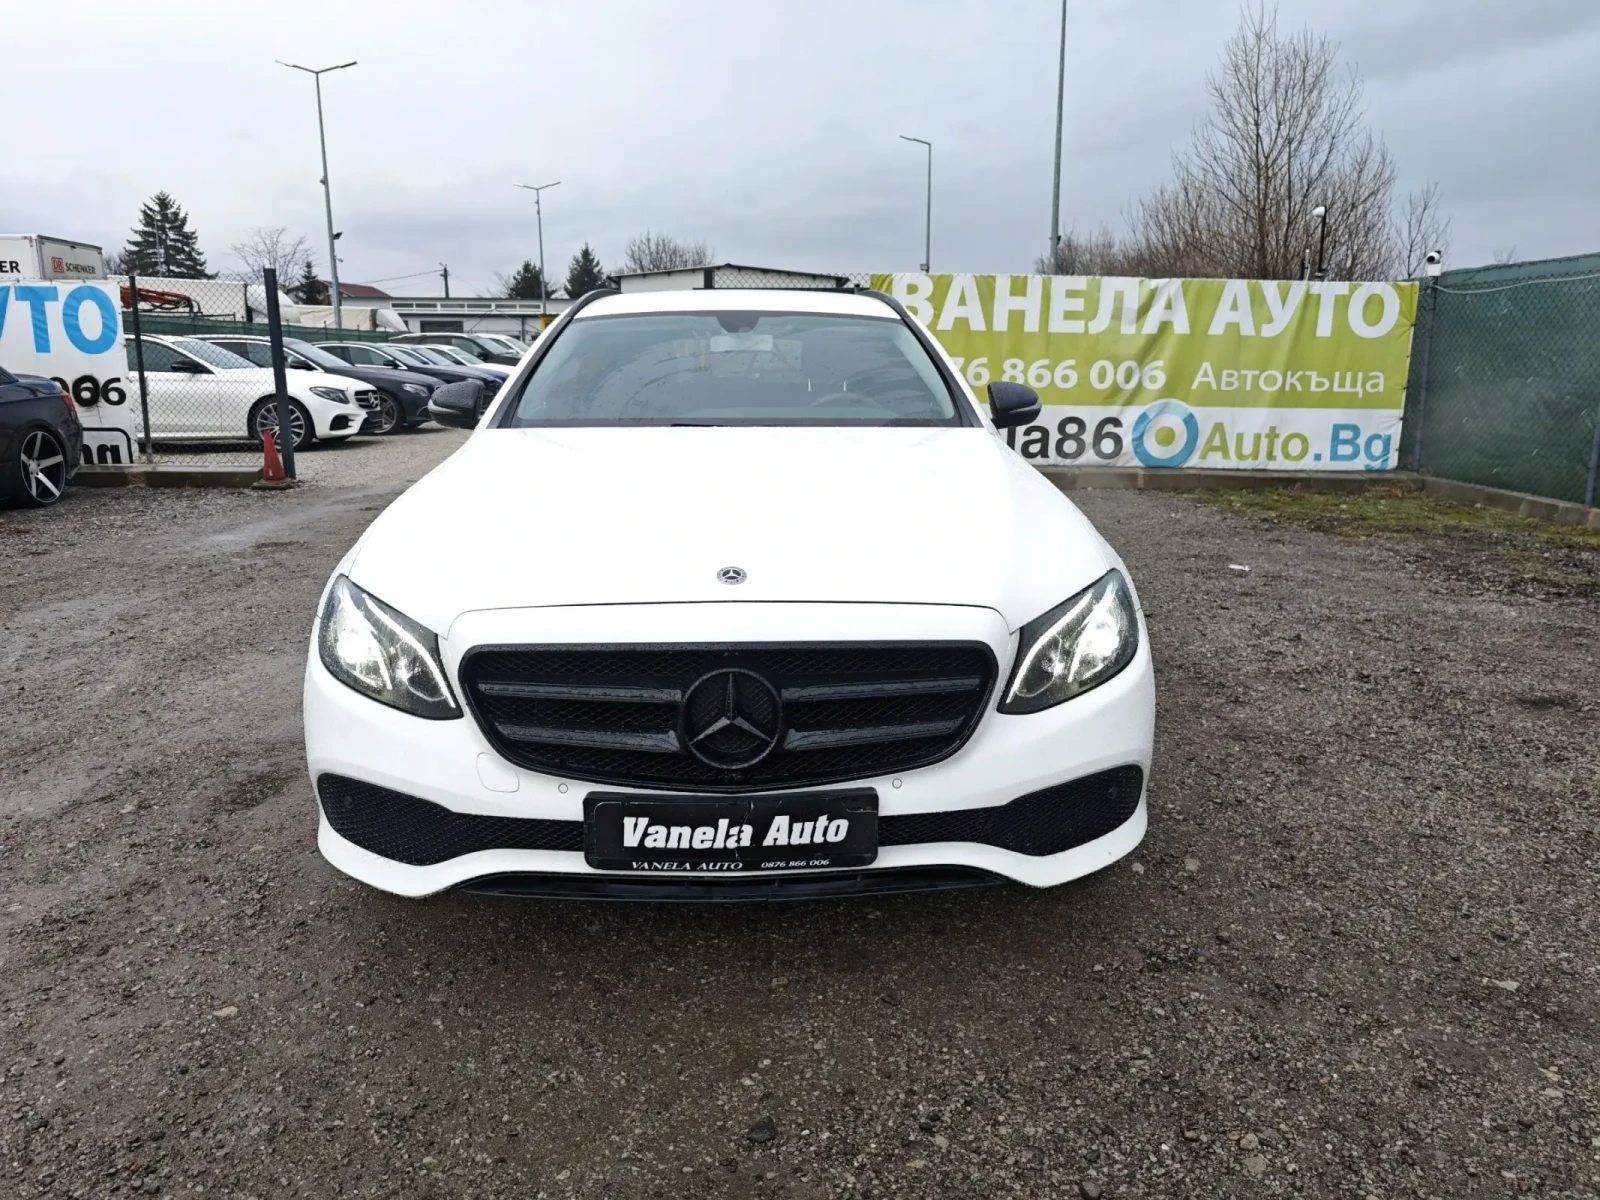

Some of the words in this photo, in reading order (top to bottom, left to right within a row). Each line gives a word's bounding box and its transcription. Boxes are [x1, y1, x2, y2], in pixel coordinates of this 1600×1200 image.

[65, 262, 97, 275] SCHENKER
[892, 272, 1191, 334] ВАНЕЛА
[1207, 280, 1401, 339] АУТО
[1001, 357, 1079, 390] 866
[1089, 359, 1167, 390] 006
[1191, 361, 1386, 399] Автокъща
[1200, 421, 1393, 471] Auto.Bg
[623, 816, 754, 849] Vanela
[762, 814, 850, 847] Auto
[631, 861, 692, 870] VANELA
[697, 861, 744, 870] AUTO
[760, 860, 788, 869] 0876
[788, 859, 808, 868] 866
[809, 858, 831, 867] 006
